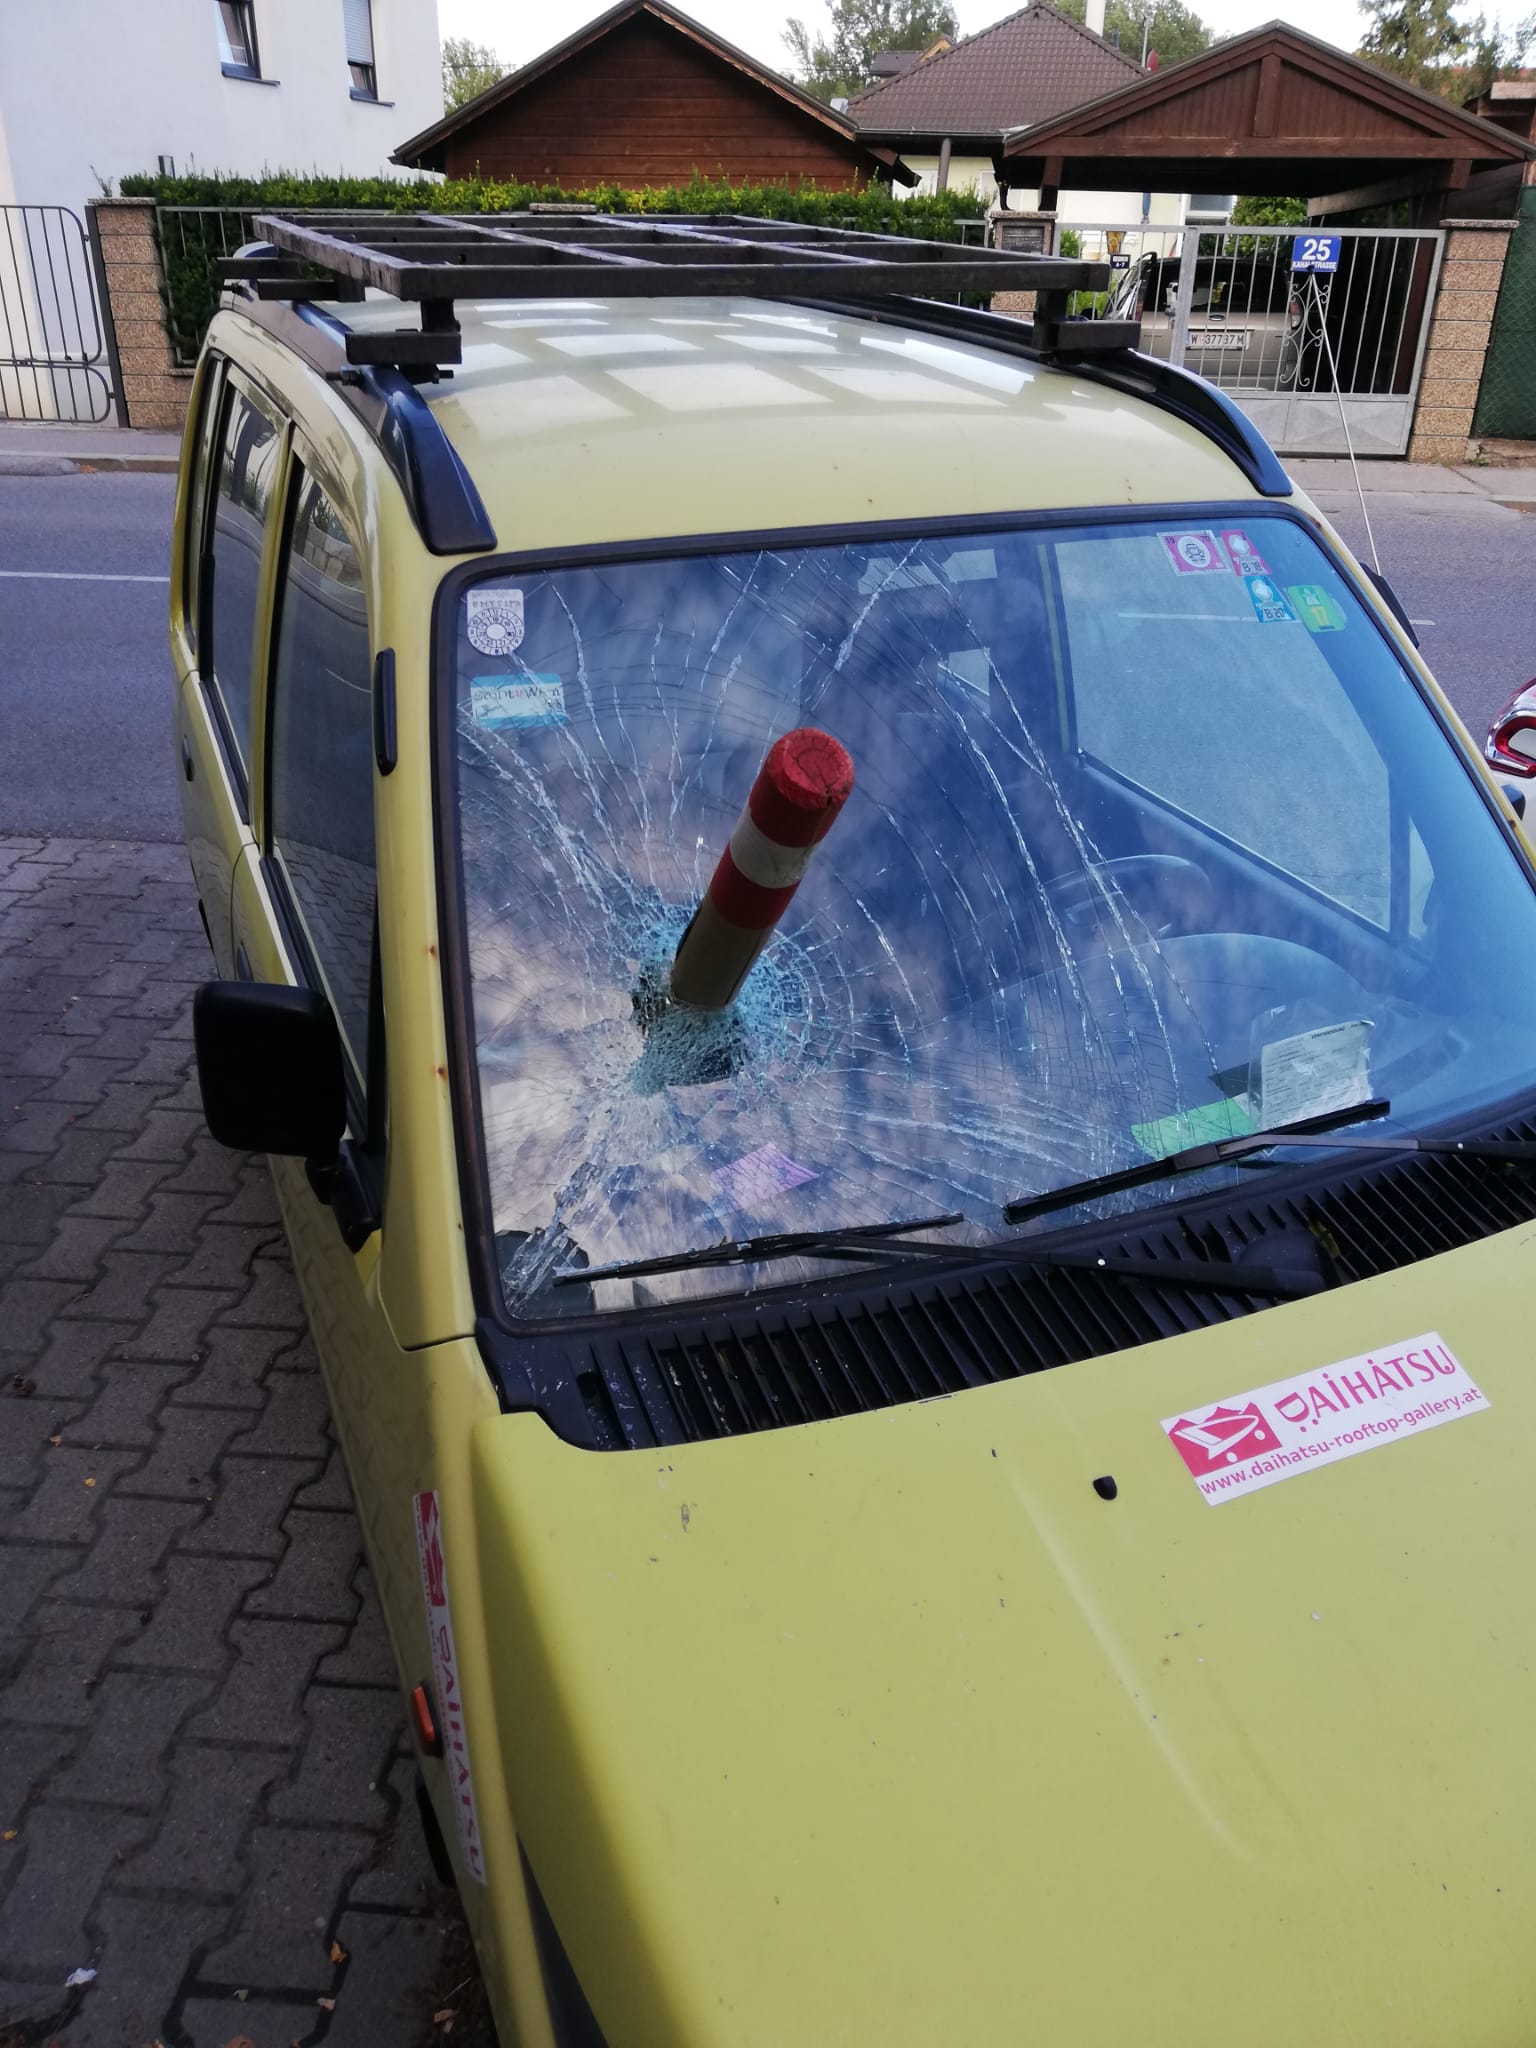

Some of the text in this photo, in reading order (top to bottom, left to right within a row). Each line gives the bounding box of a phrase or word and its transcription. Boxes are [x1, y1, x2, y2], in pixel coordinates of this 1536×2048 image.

[1302, 238, 1332, 261] 25
[1191, 334, 1198, 345] W
[1242, 562, 1251, 573] B
[1264, 608, 1273, 619] B
[525, 687, 561, 699] Win
[1274, 1344, 1457, 1432] DAIHATSU
[1200, 1387, 1483, 1494] www.daihatsu-rooftop-gallery.at
